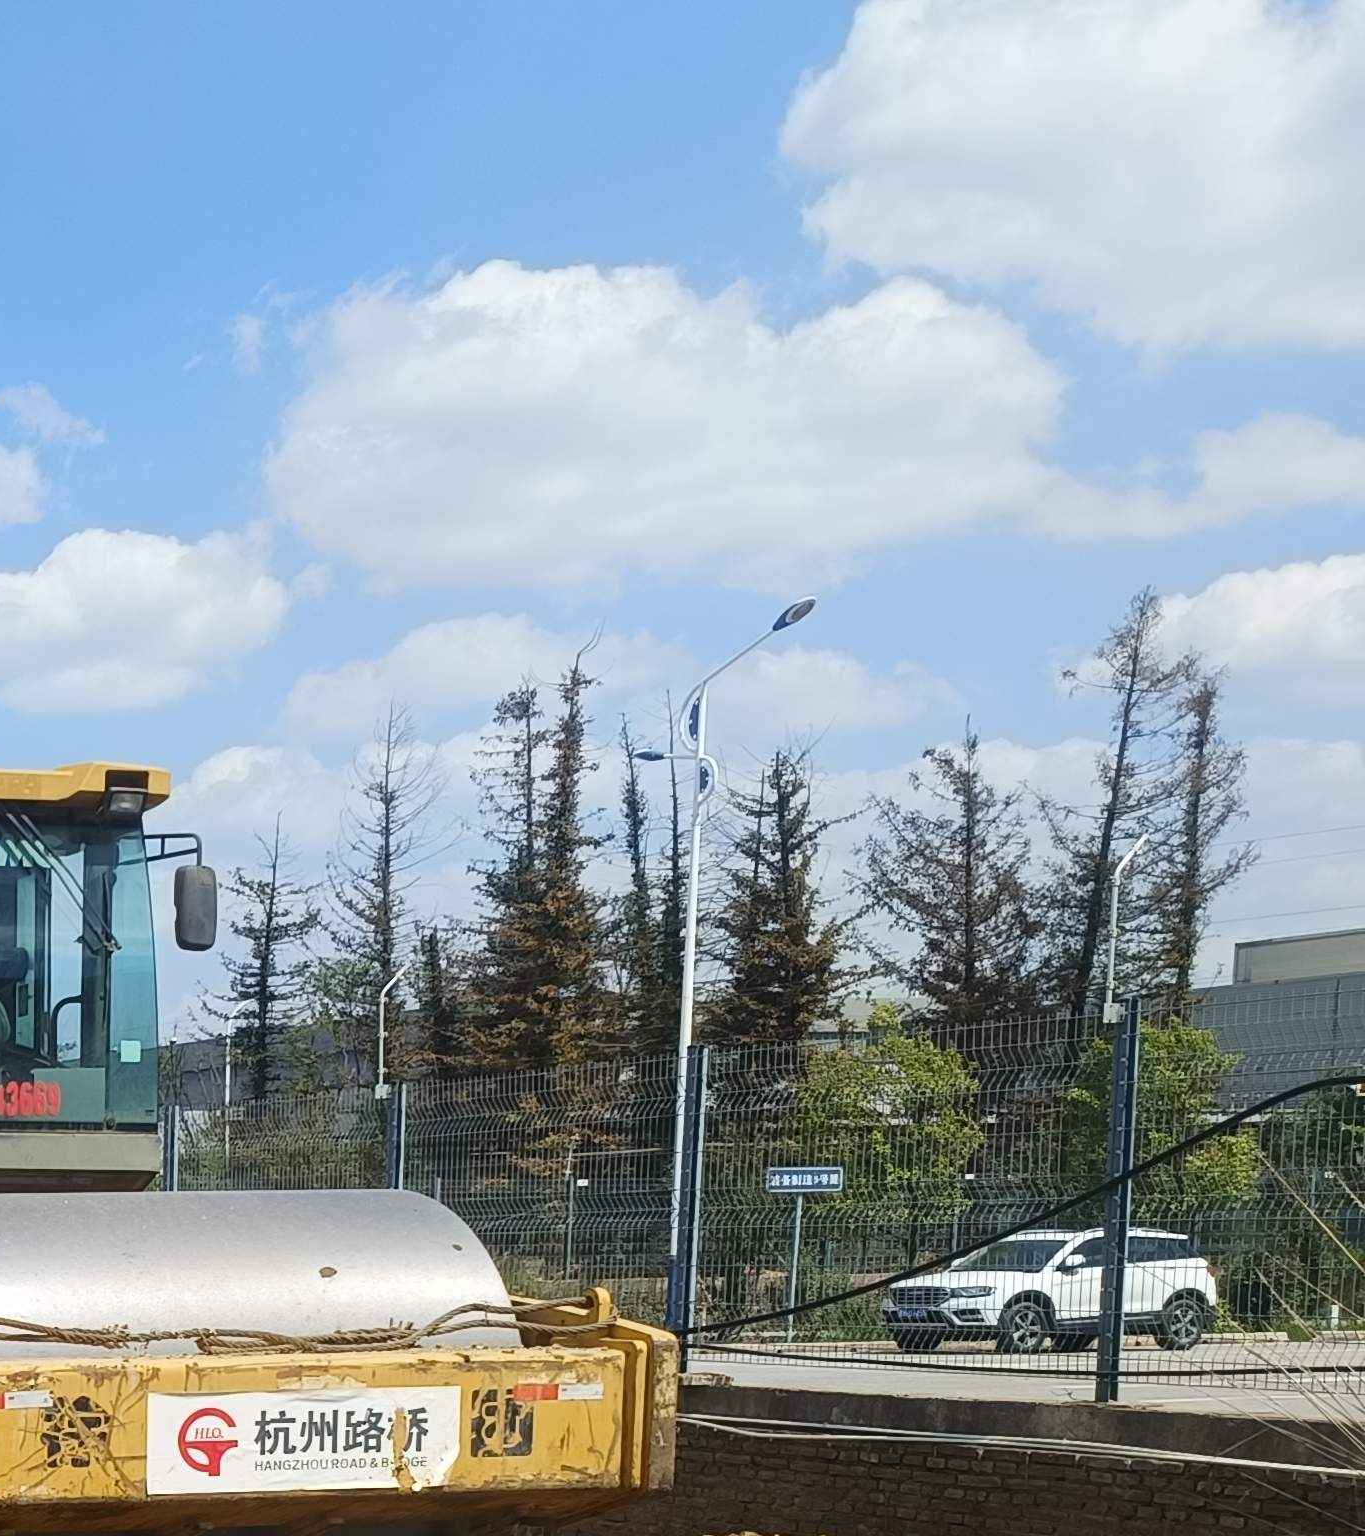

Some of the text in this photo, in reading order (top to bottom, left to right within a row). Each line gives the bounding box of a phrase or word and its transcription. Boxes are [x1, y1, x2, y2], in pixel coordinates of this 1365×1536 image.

[254, 1407, 428, 1455] 杭州路桥
[254, 1459, 329, 1472] HANGZHOU
[331, 1458, 367, 1470] ROAD
[381, 1456, 428, 1469] BDGE
